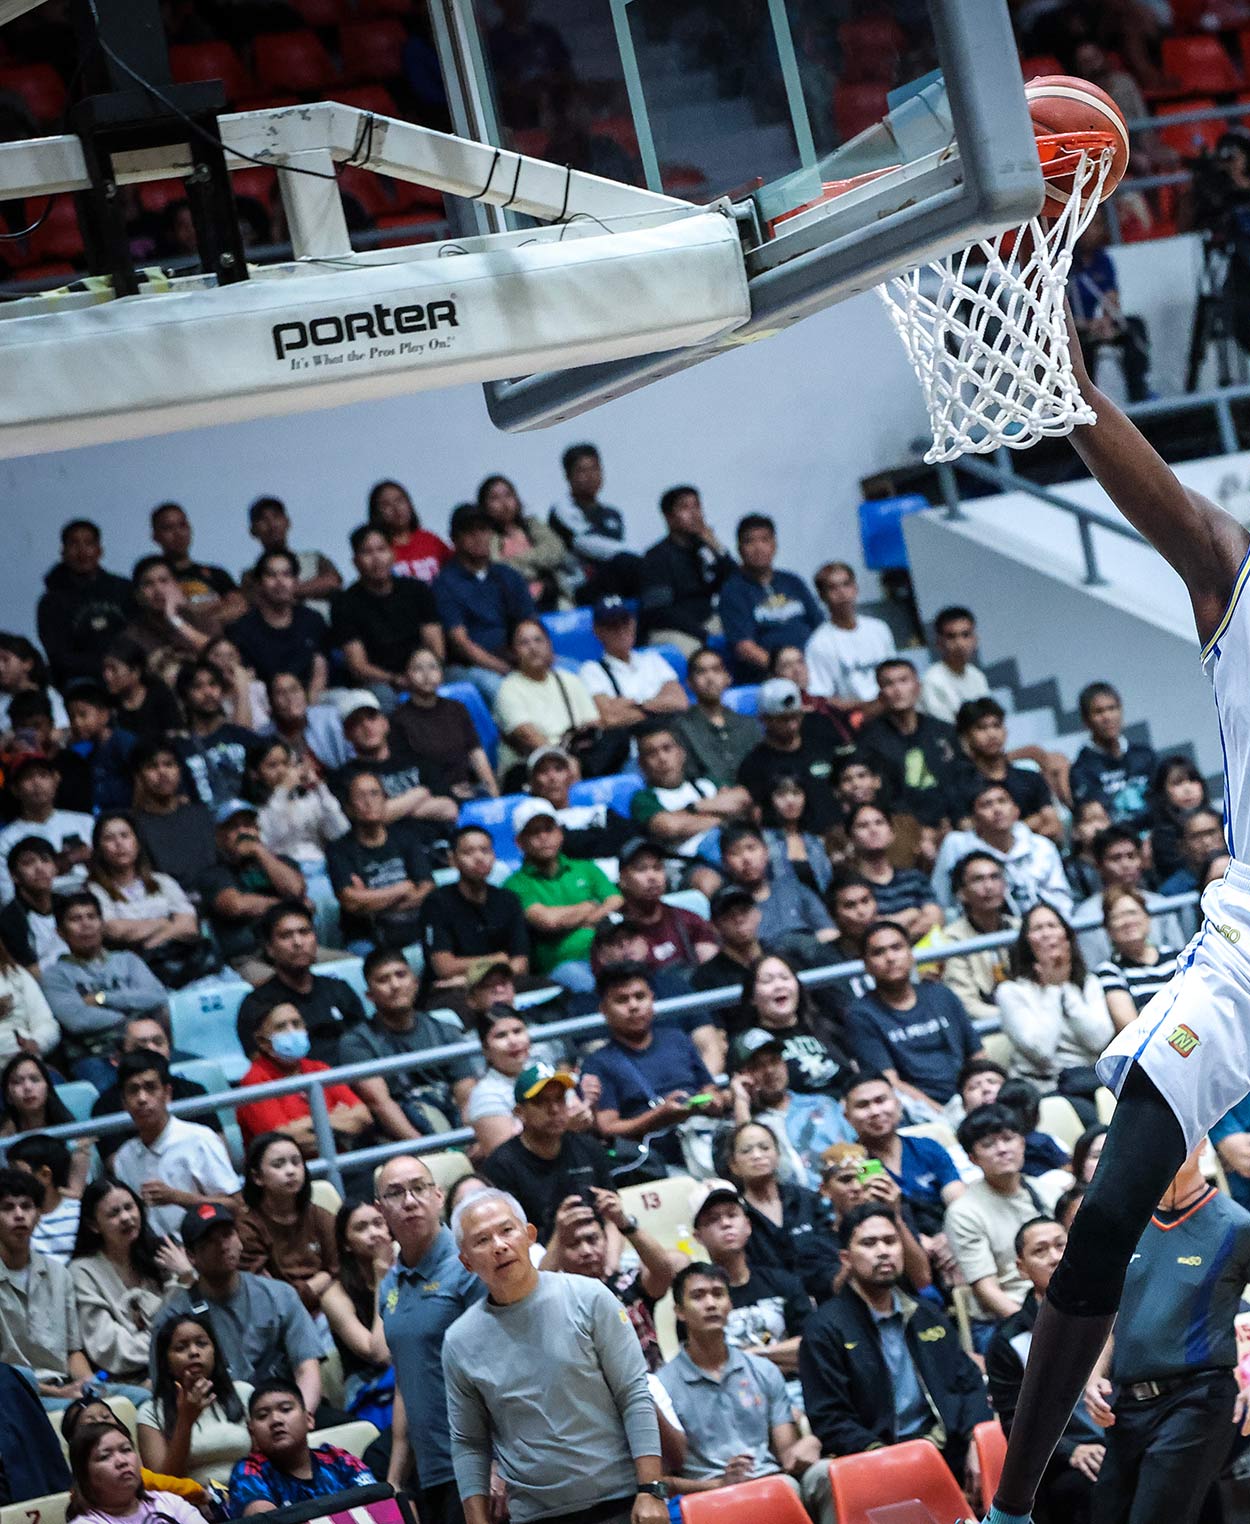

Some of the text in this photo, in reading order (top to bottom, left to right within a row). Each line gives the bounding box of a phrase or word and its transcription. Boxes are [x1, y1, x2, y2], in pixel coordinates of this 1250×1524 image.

[313, 351, 344, 366] What
[347, 349, 366, 361] the
[369, 345, 395, 359] Pros
[399, 340, 426, 355] Play
[1166, 1026, 1202, 1053] TNT
[641, 1191, 662, 1211] 13
